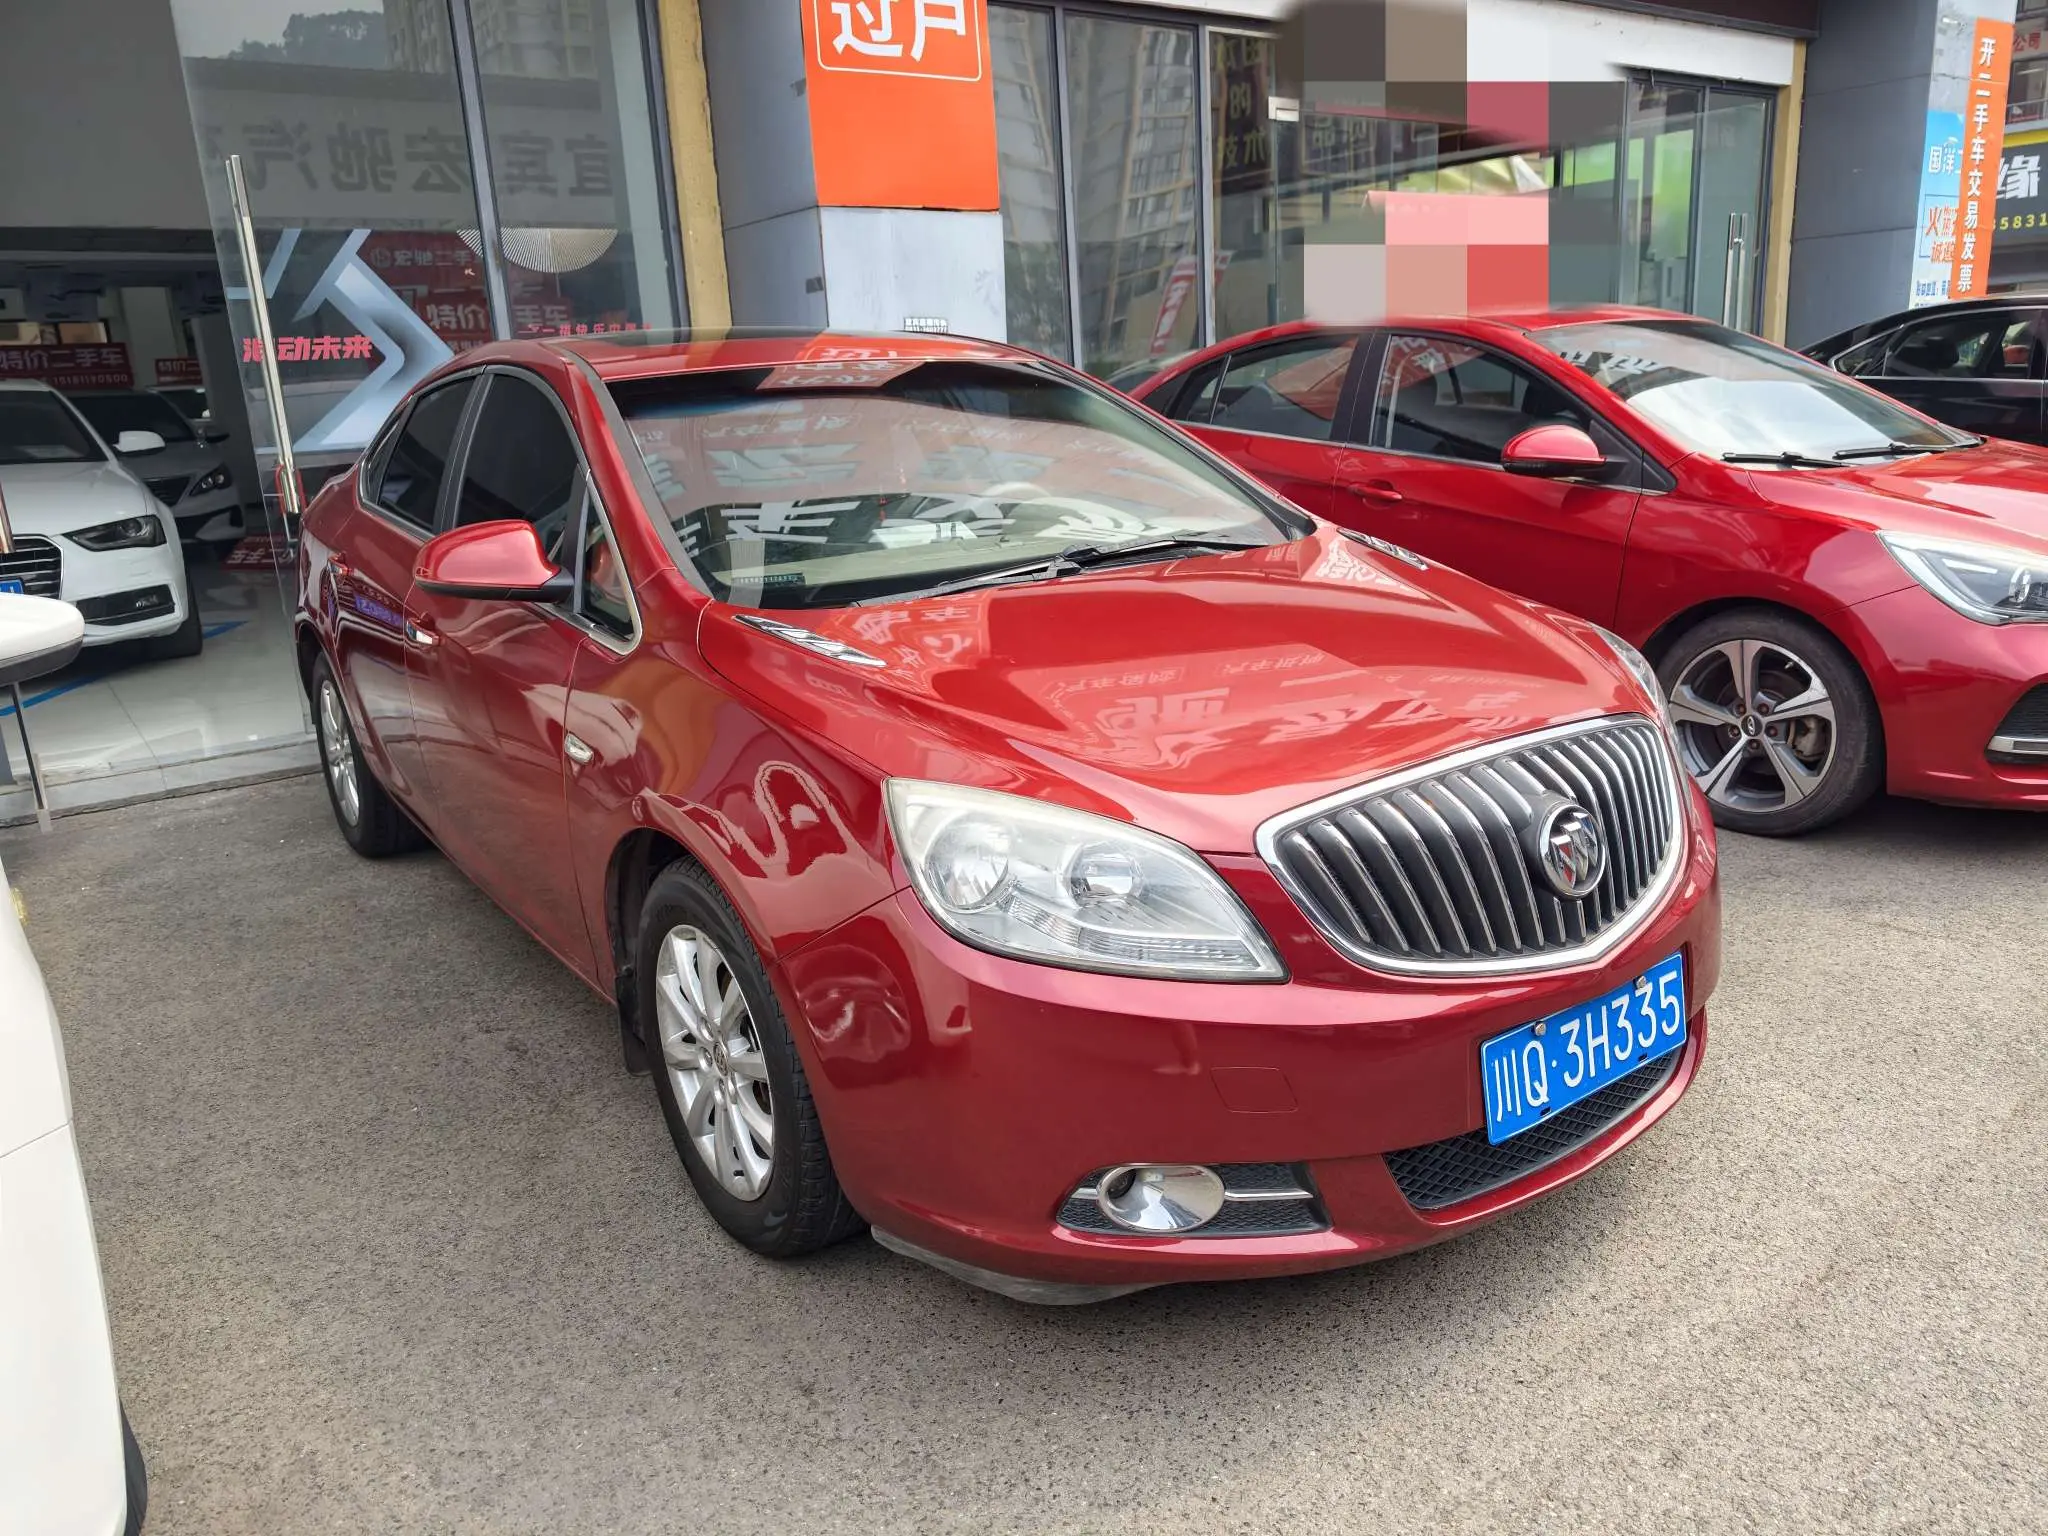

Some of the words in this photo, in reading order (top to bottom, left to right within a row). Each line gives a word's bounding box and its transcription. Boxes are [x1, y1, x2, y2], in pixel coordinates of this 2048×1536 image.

[831, 0, 966, 62] 过户
[1953, 37, 1997, 292] 开二手车交易发票
[1992, 213, 2048, 231] 5831
[0, 349, 125, 370] 特价二手车
[1493, 969, 1681, 1122] 川Q·3H335
